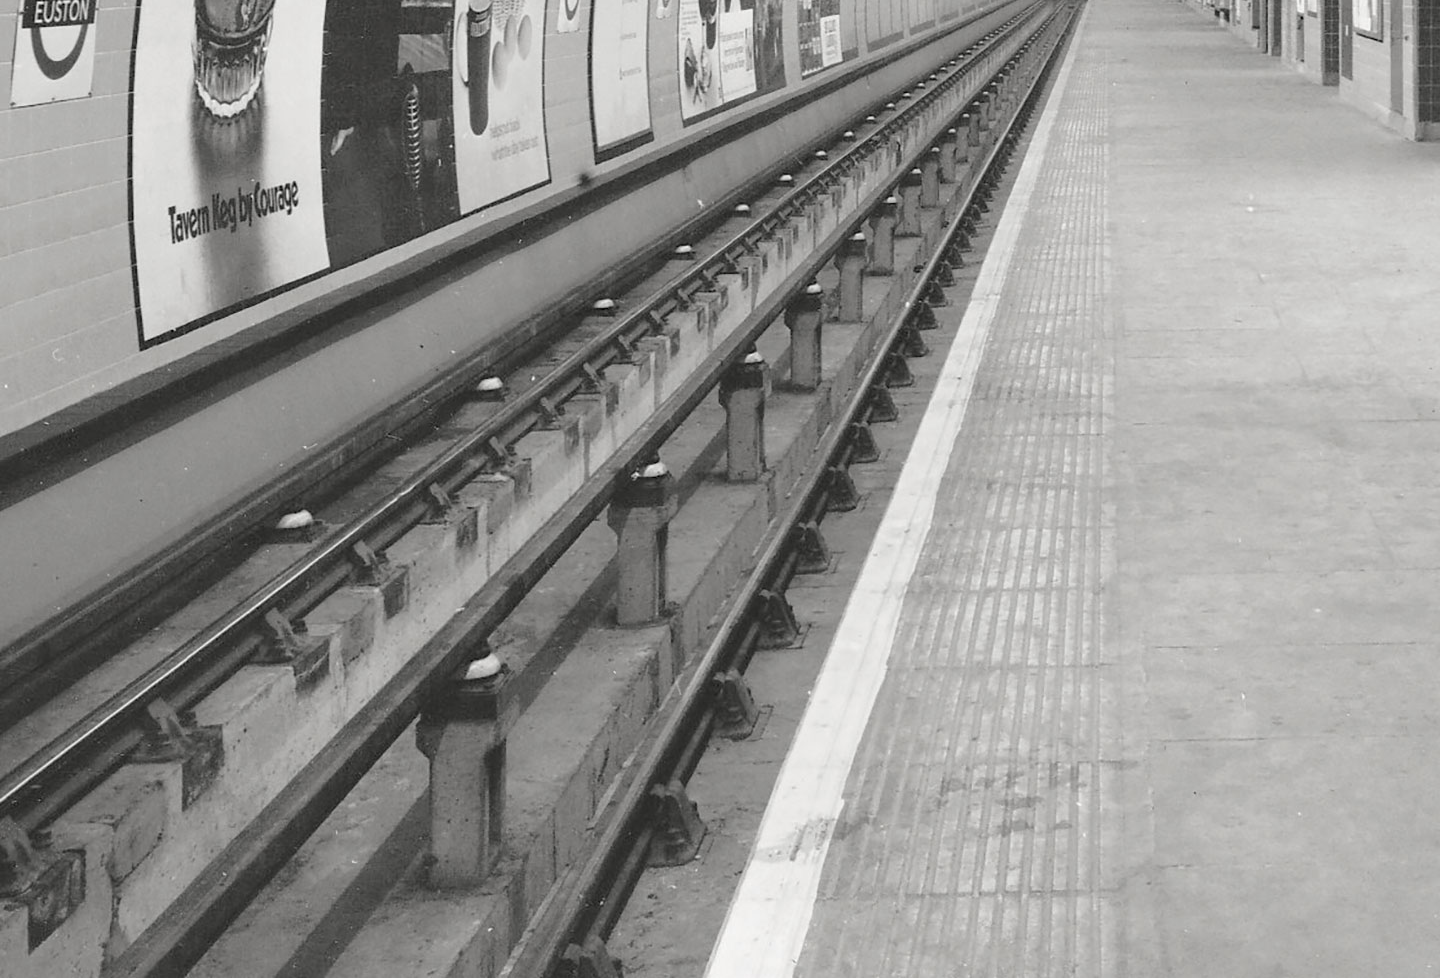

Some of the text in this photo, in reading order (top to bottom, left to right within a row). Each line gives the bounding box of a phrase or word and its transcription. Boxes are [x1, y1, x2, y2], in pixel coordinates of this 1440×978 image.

[168, 180, 299, 245] Tavern Keg by Courage
